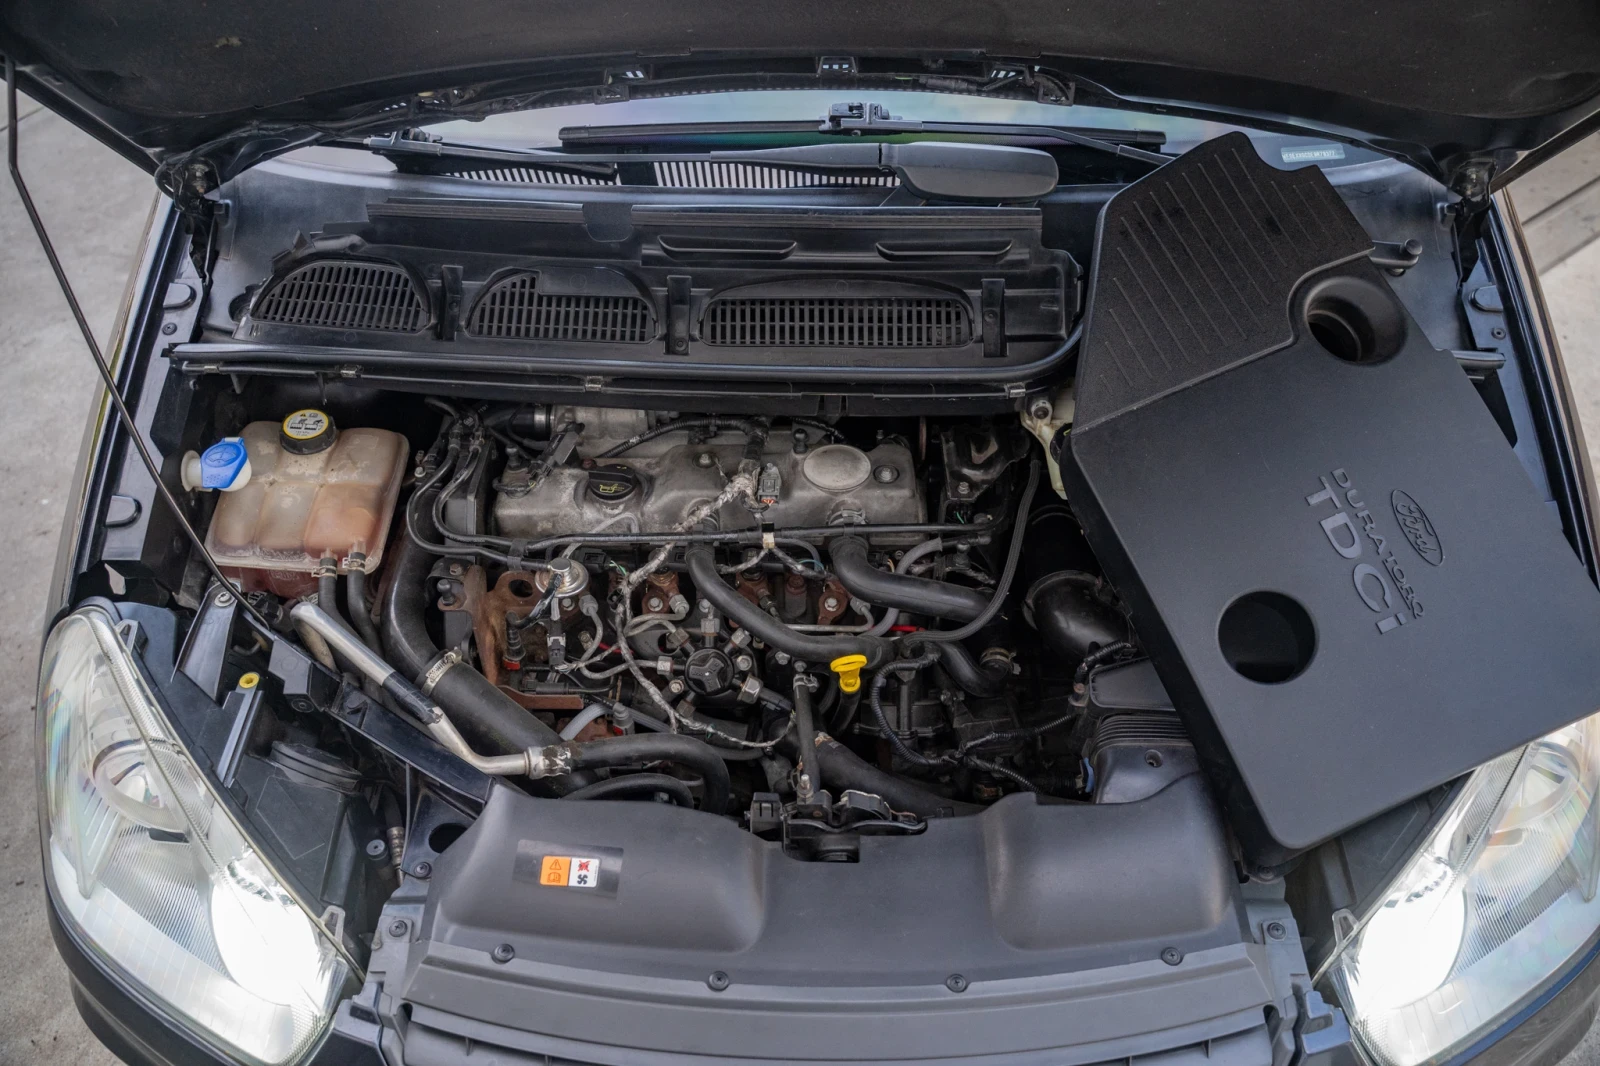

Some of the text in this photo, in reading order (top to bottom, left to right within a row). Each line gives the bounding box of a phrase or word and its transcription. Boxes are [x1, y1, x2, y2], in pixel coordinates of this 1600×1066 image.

[1305, 476, 1407, 635] TDCi
[1331, 468, 1424, 619] DURATORQ
[1395, 500, 1438, 556] Ford
